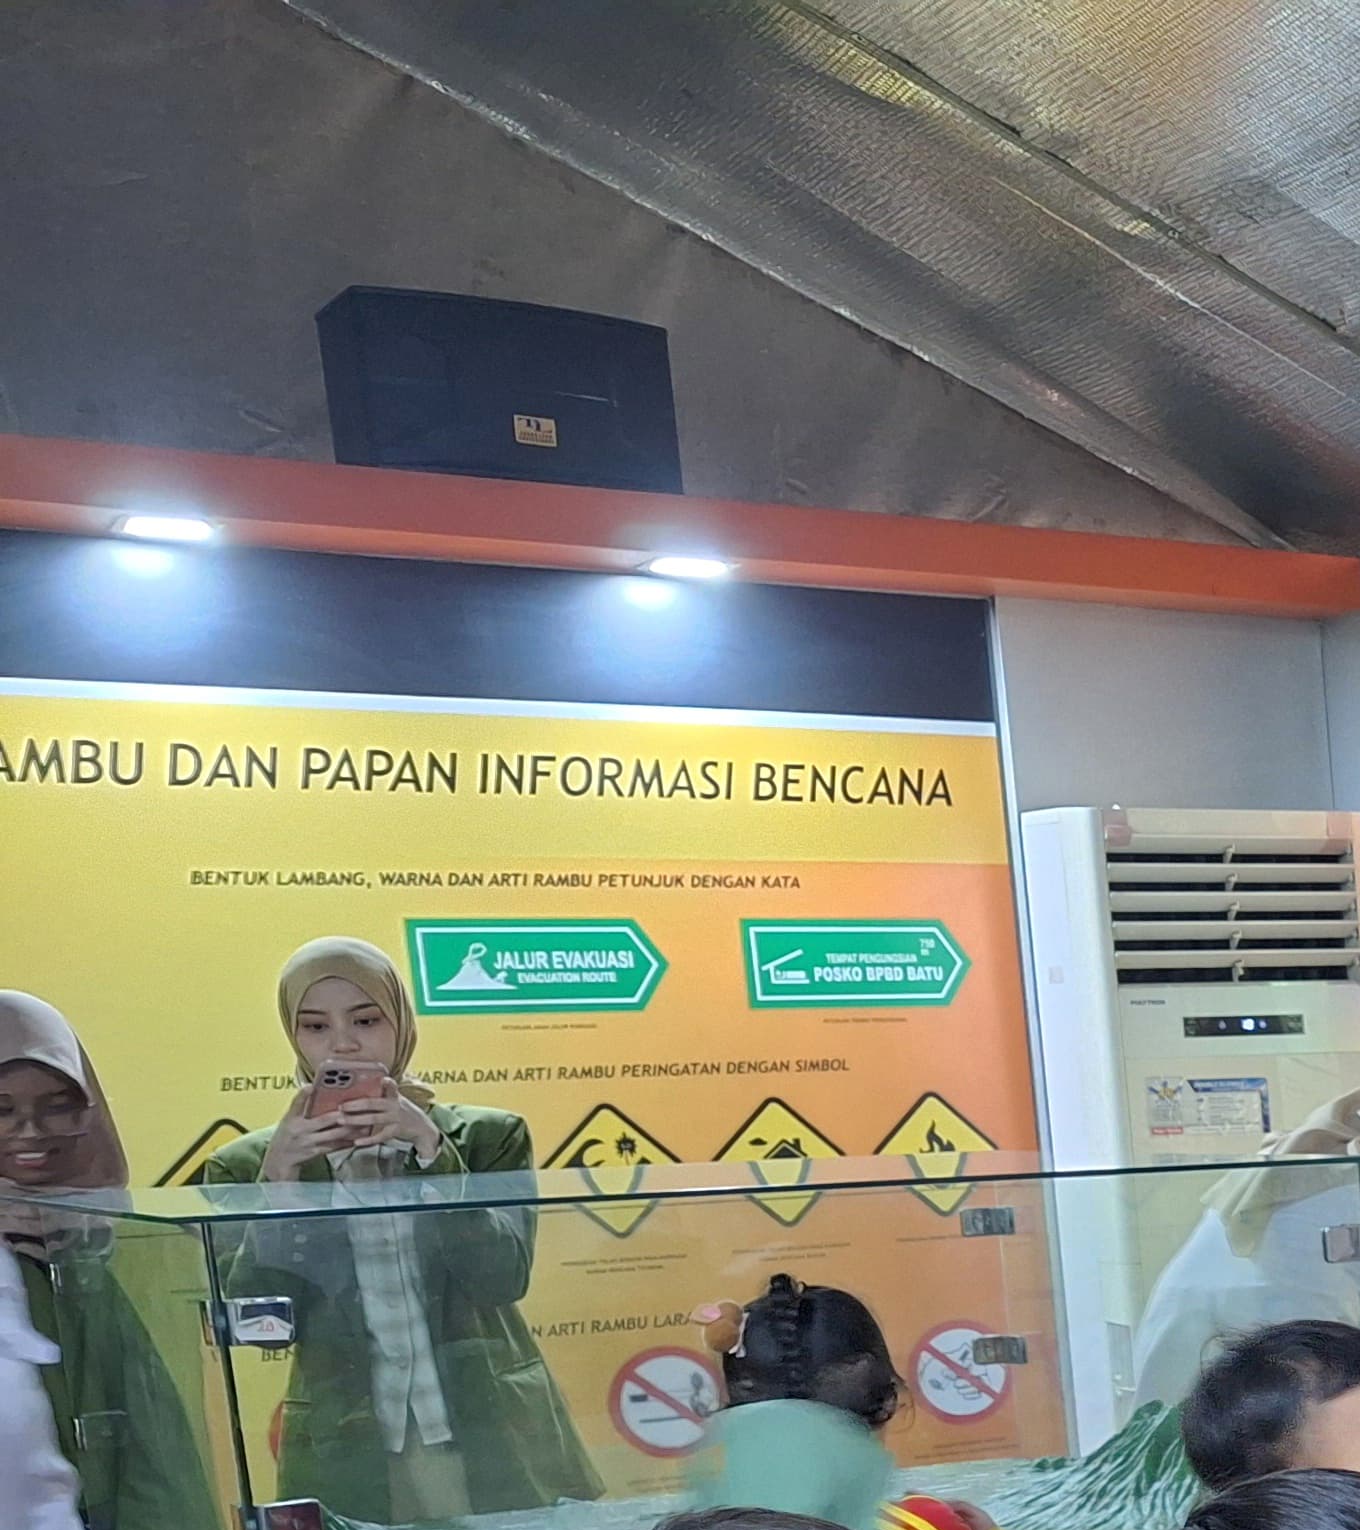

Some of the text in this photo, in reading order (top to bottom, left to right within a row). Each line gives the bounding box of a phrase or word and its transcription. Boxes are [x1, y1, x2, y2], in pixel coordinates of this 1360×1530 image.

[0, 738, 953, 807] AMBU DAN PAPAN INFORMASI BENCANA
[190, 871, 800, 889] BENTUK LAMBANG, WARNA DAN ARTI RAMBU PETUNJUK DENGAN KATA
[493, 950, 635, 969] JALUR EVAKUASI
[825, 953, 857, 963] TEMPAT
[517, 972, 617, 984] EVACUATION ROUTE
[813, 966, 943, 982] POSKO BPBD BATU
[221, 1076, 296, 1092] BENTUK
[473, 1069, 508, 1082] DAN
[512, 1067, 550, 1081] ARTI
[557, 1065, 616, 1080] RAMBU
[621, 1062, 720, 1077] PERINGATAN
[726, 1060, 790, 1074] DENGAN
[795, 1058, 851, 1072] SIMBOL
[547, 1321, 585, 1337] ARTI
[591, 1316, 649, 1334] RAMBU
